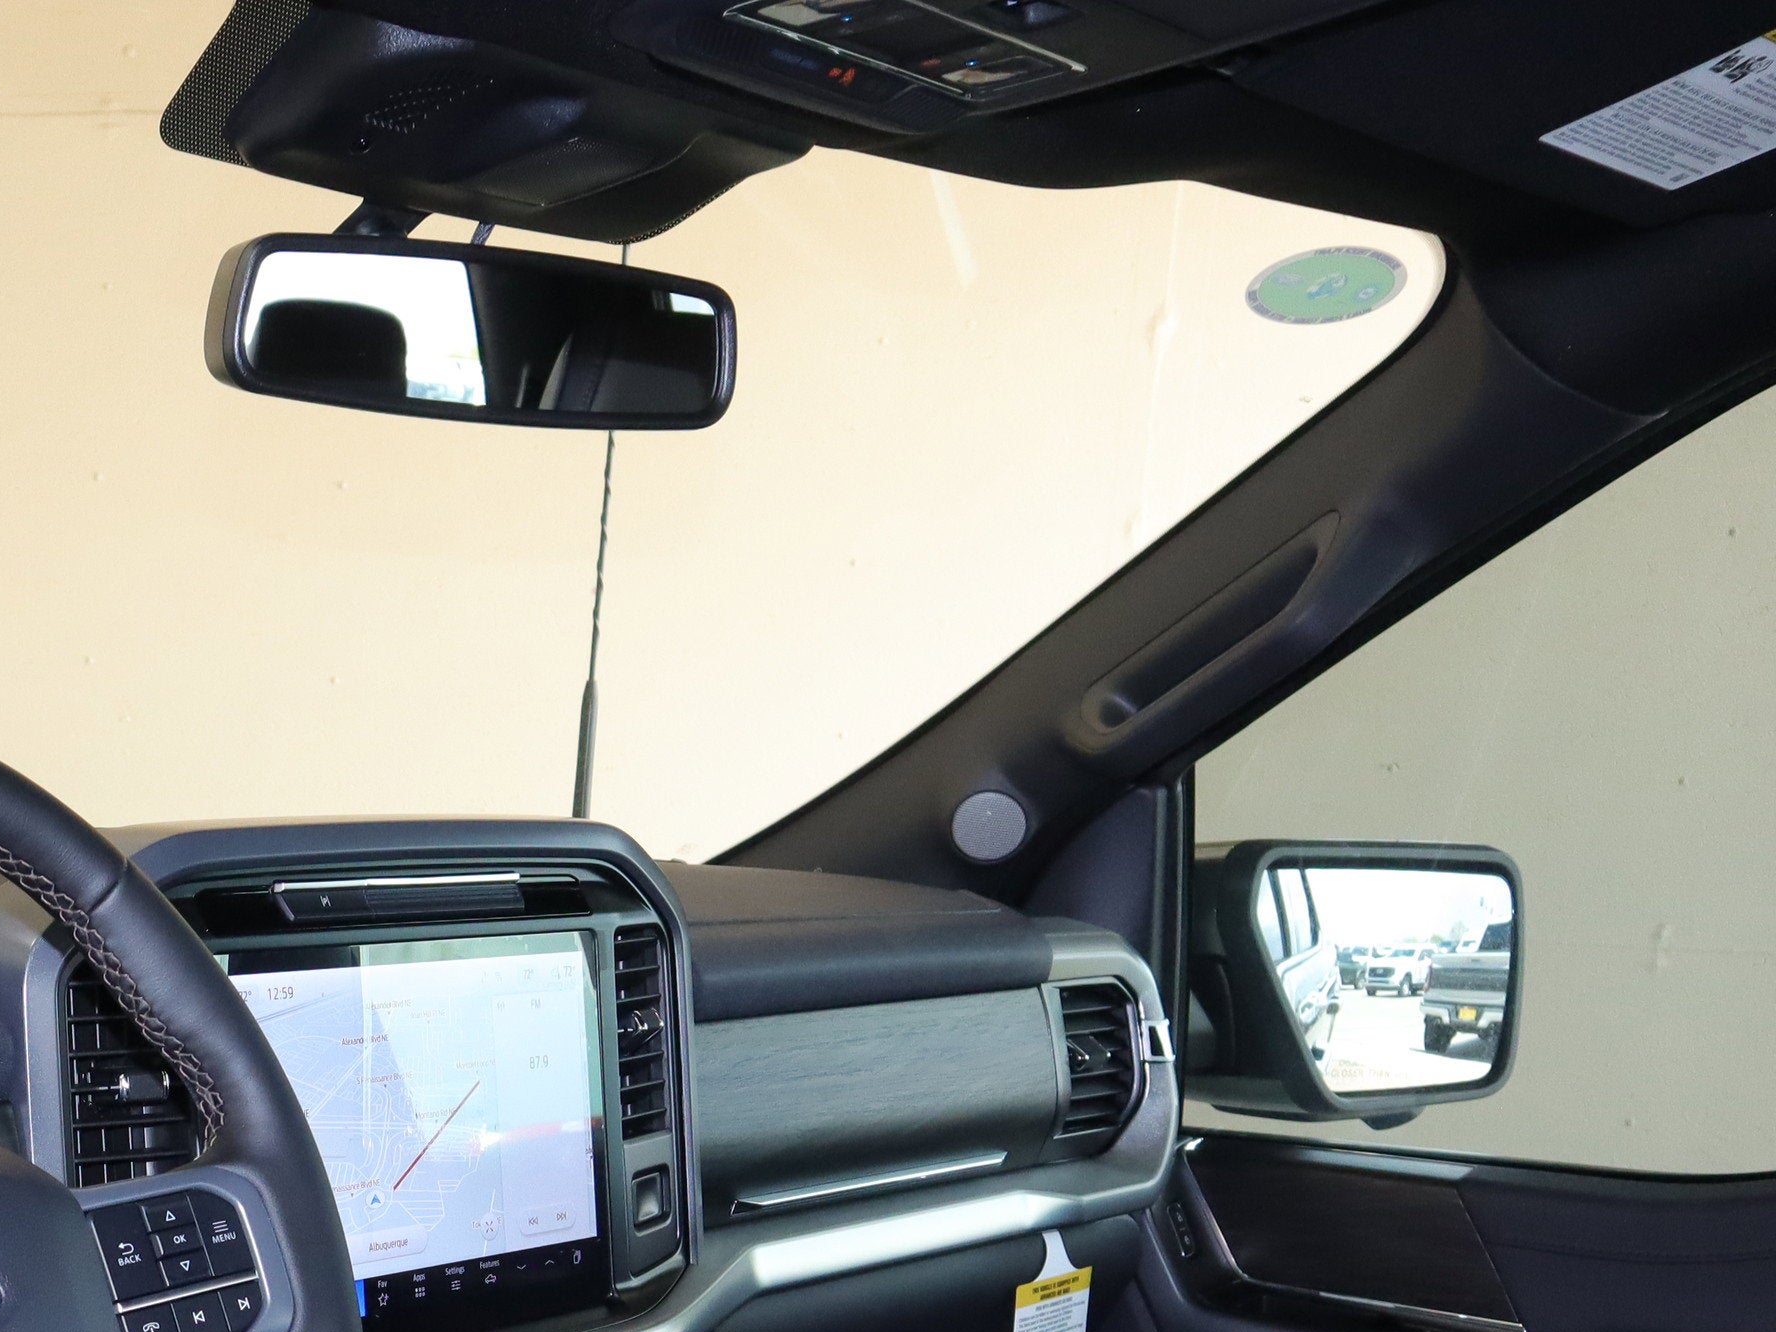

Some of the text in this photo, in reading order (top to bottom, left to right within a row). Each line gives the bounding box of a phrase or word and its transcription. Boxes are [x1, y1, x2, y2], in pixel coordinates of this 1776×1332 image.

[267, 986, 294, 1001] 12:59
[530, 998, 542, 1010] FM
[529, 1055, 549, 1070] 87.9
[173, 1233, 187, 1245] OK
[211, 1230, 237, 1245] MENU
[368, 1237, 409, 1252] Albuquerque
[117, 1253, 142, 1267] BACK
[479, 1259, 500, 1270] Features
[445, 1265, 466, 1276] Settings
[377, 1279, 388, 1289] Fav
[413, 1273, 426, 1283] Apps
